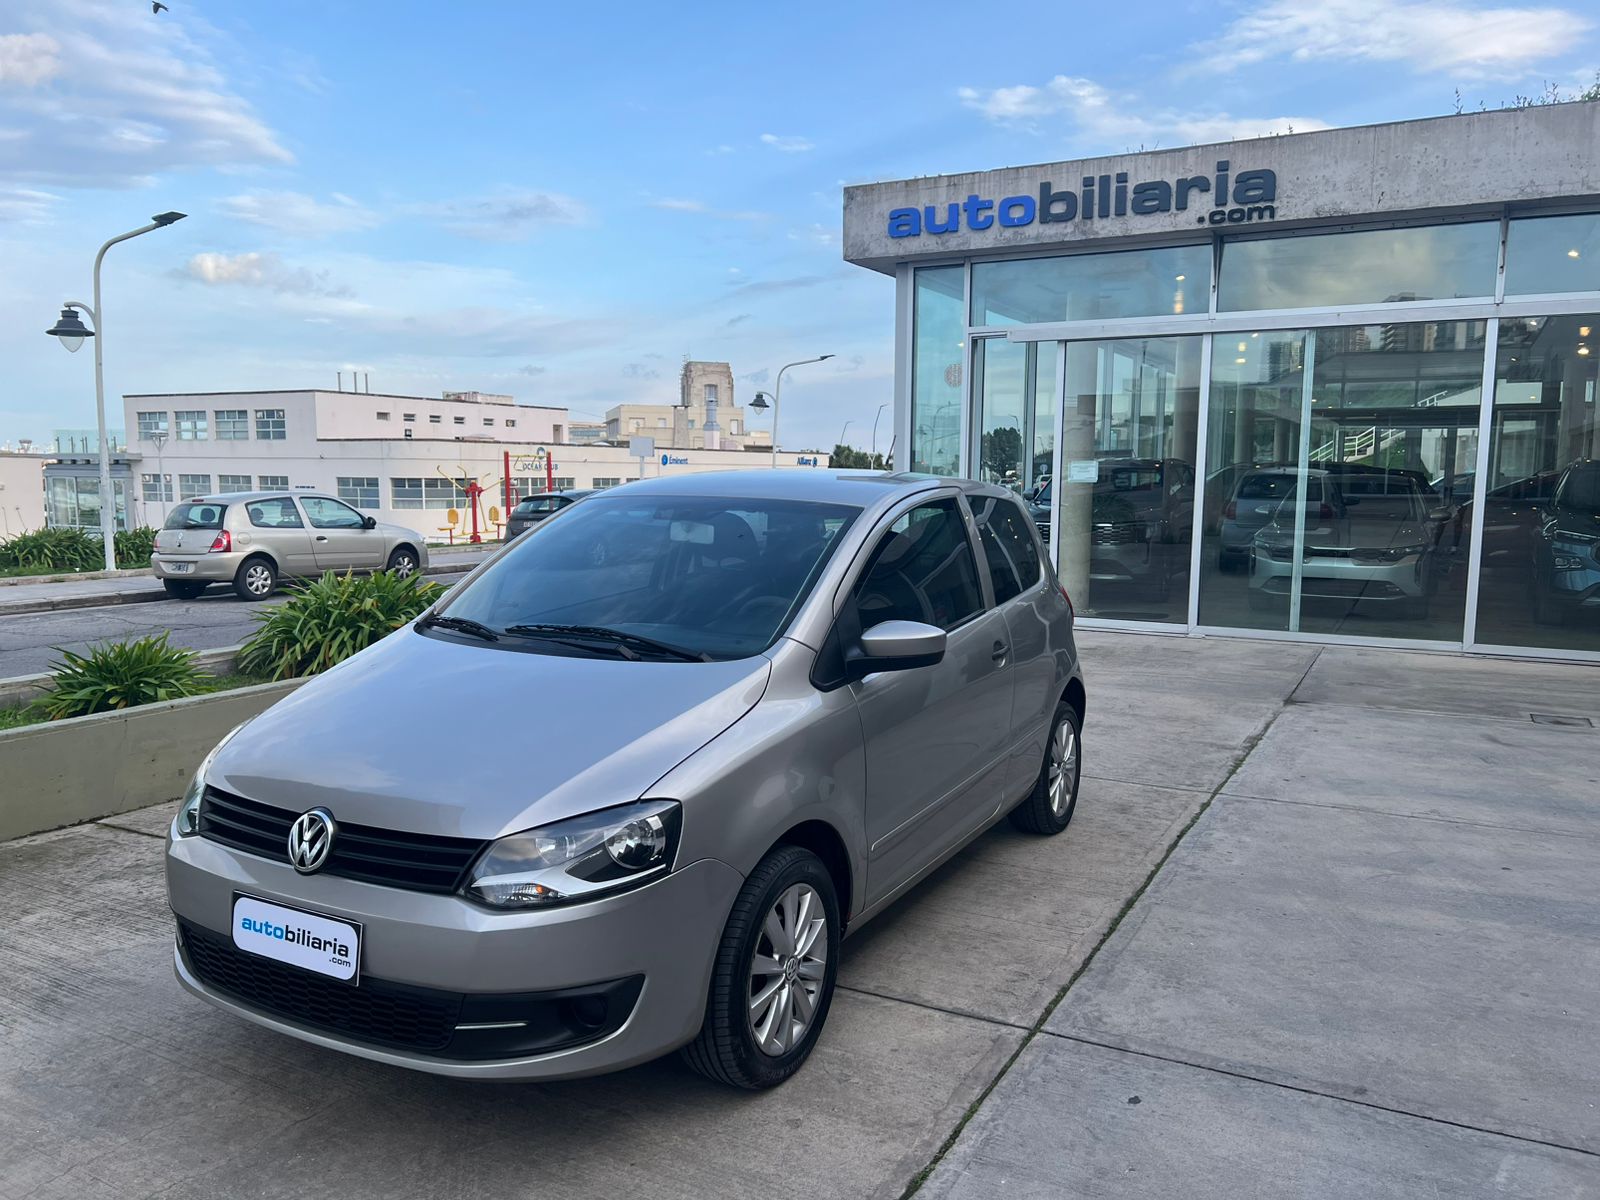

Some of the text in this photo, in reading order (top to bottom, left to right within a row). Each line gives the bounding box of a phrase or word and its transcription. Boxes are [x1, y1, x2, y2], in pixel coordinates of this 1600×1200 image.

[888, 160, 1277, 238] autobiliaria
[1197, 204, 1275, 225] .com
[544, 463, 559, 471] CUB
[241, 917, 349, 958] autobiliaria
[328, 956, 351, 968] .com
